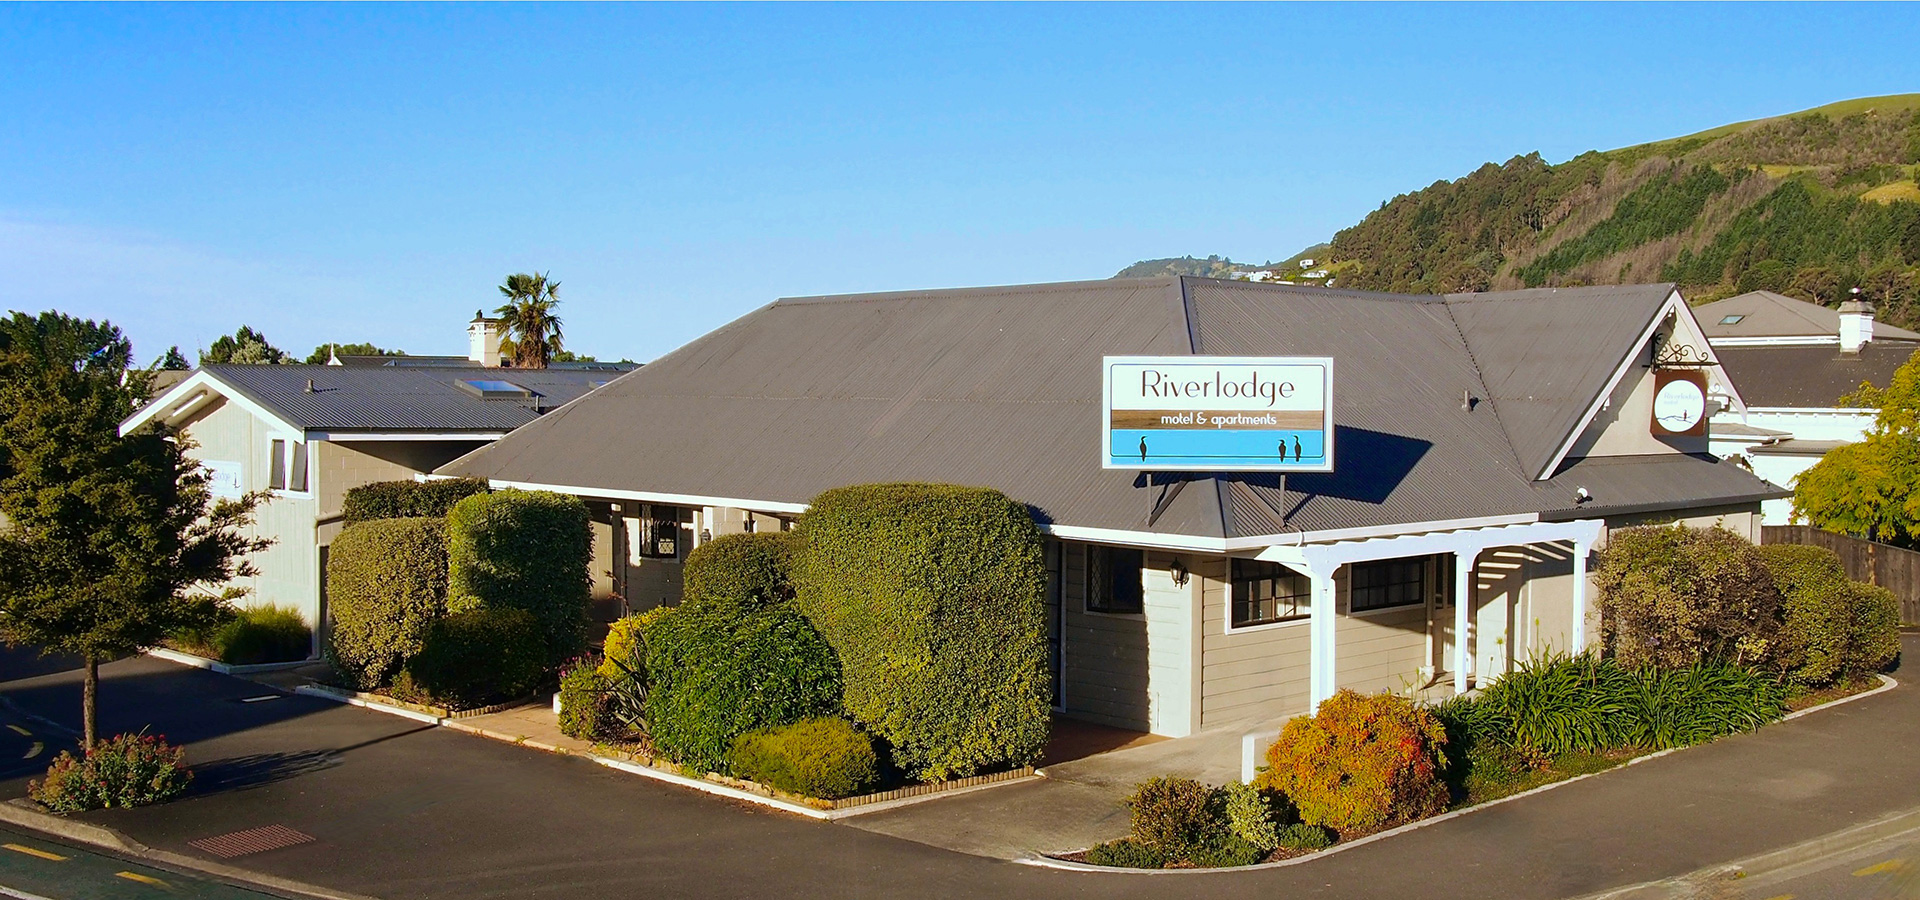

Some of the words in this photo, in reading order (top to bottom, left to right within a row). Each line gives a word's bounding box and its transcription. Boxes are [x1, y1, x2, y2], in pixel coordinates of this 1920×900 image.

[1142, 370, 1295, 407] Riverlodge
[1161, 412, 1193, 425] motel
[1196, 412, 1208, 425] &
[1211, 412, 1277, 429] apartments
